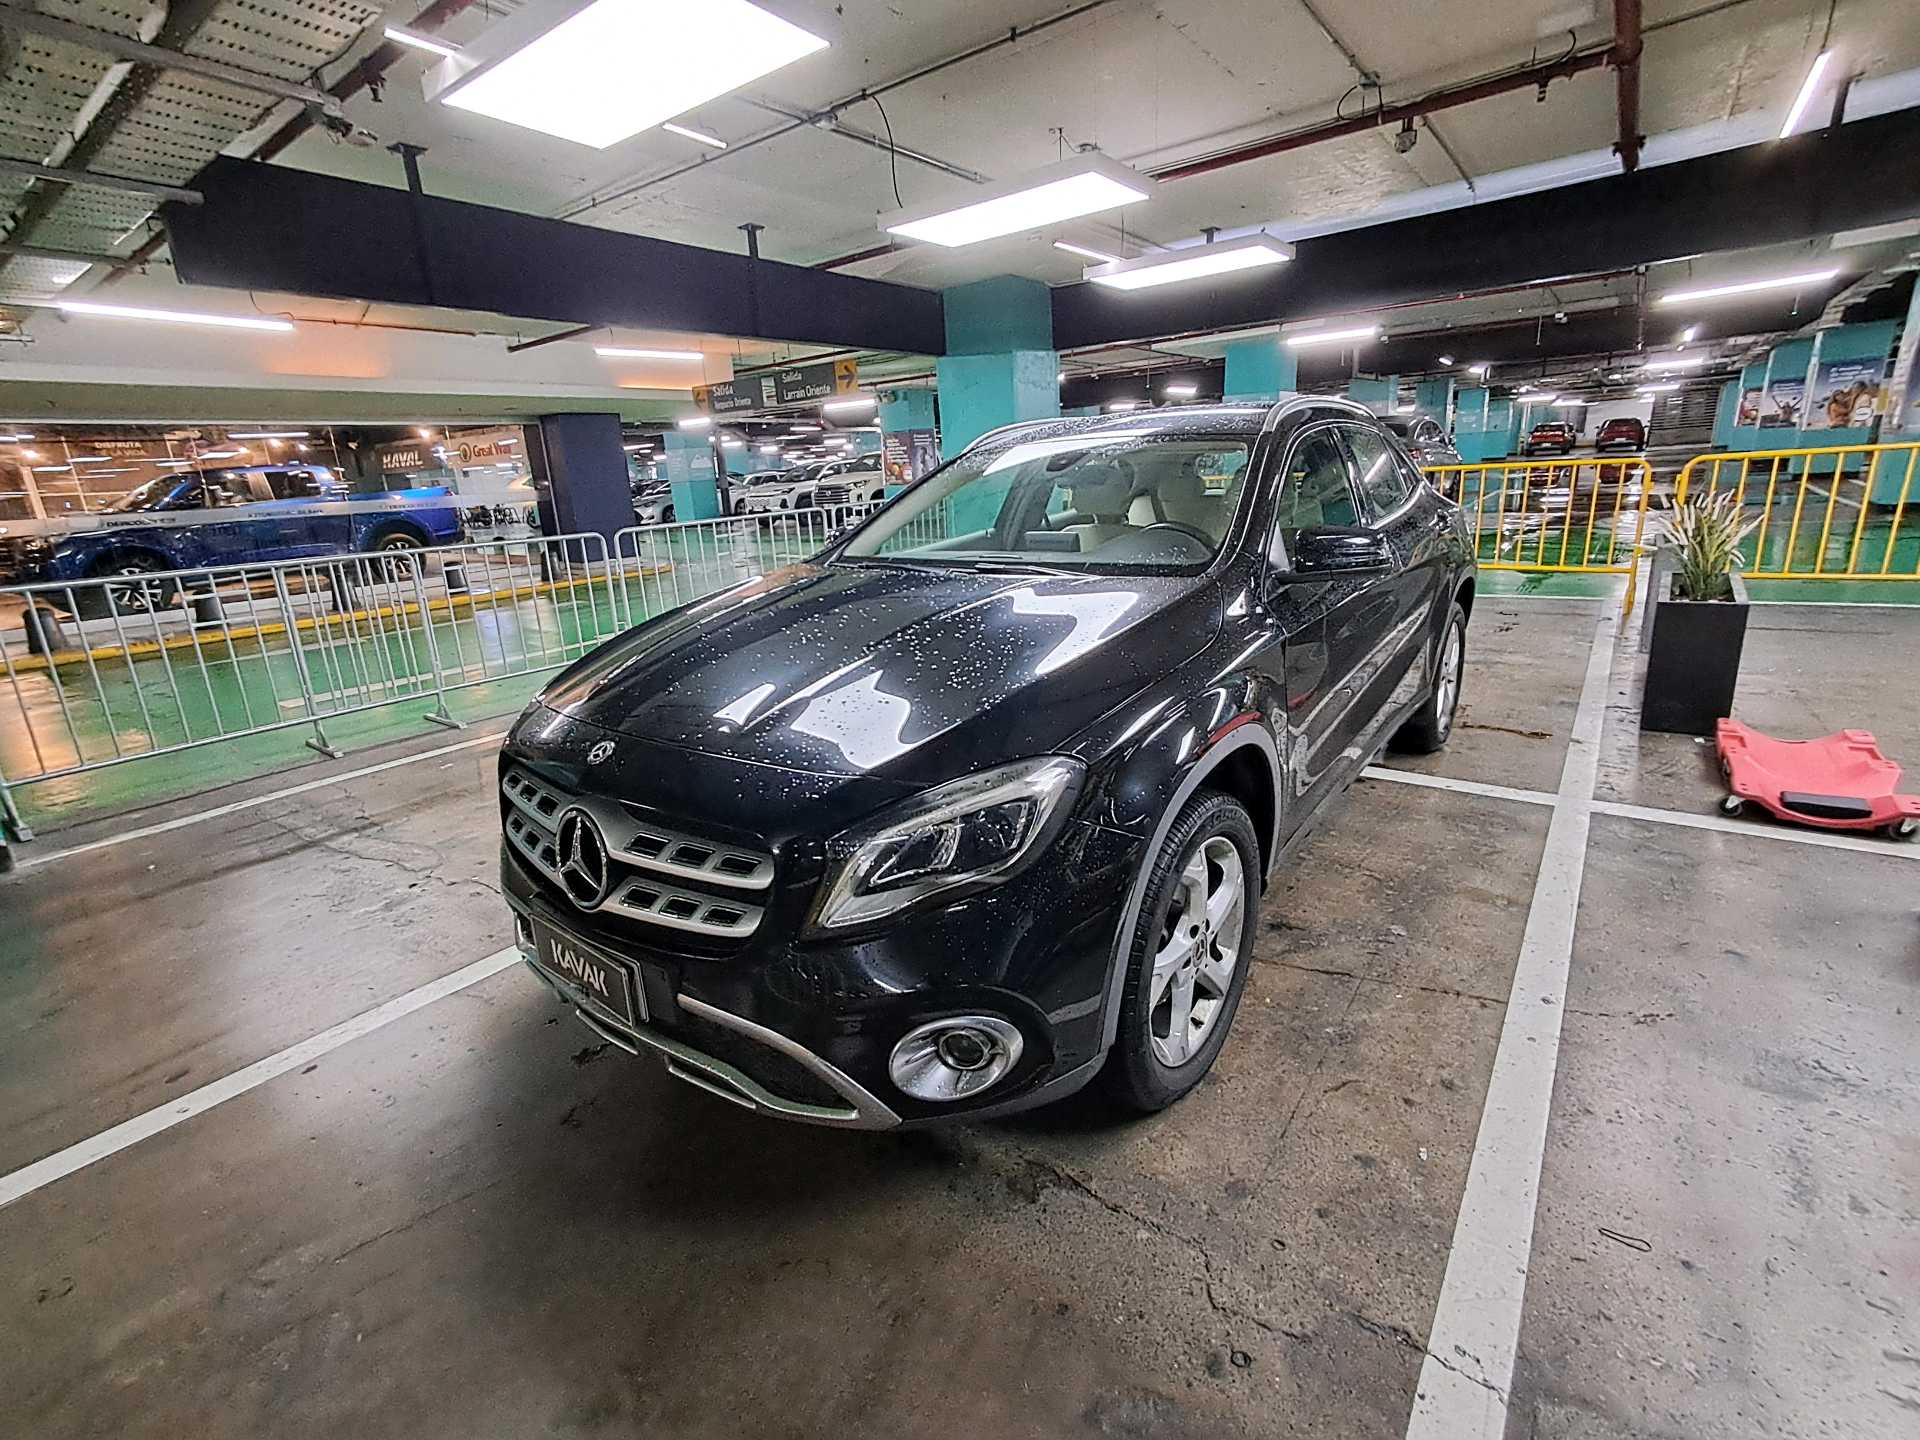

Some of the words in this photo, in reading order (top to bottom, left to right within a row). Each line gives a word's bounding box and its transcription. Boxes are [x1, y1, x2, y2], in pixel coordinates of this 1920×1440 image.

[782, 370, 802, 383] Salida
[713, 384, 733, 397] Salida
[806, 384, 832, 398] Oriente
[95, 441, 142, 449] DISFRUTA
[472, 443, 494, 457] Great
[382, 450, 423, 469] HAVAL
[550, 938, 609, 997] KAVAK
